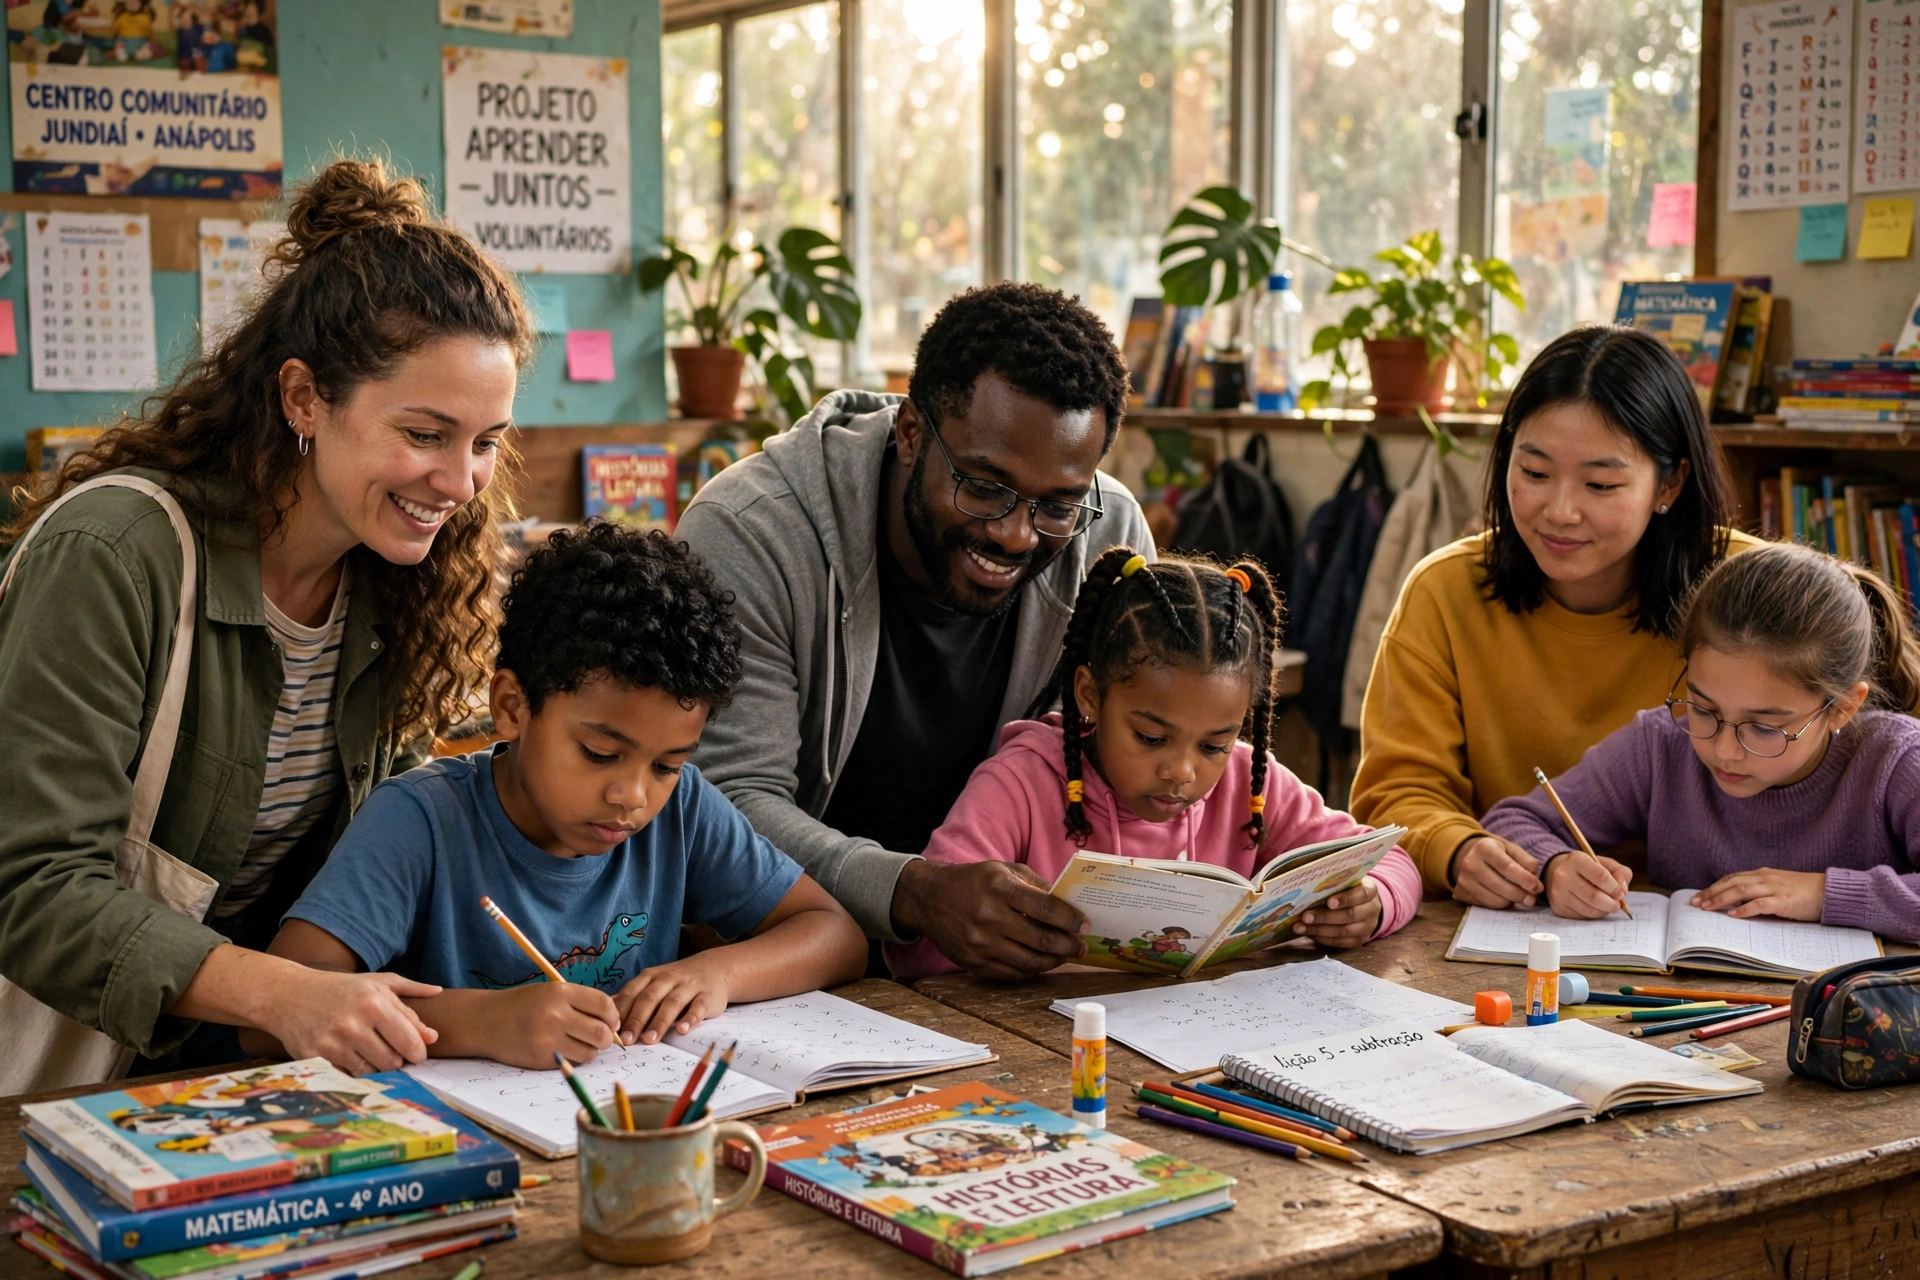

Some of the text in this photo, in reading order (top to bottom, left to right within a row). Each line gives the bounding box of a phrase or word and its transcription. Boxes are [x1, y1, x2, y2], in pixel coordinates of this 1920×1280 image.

[26, 83, 267, 120] CENTRO COMUNITÁRIO
[478, 82, 597, 123] PROJETO
[41, 117, 128, 146] JUNDIAÍ
[153, 125, 255, 152] ANÁPOLIS
[465, 126, 609, 167] APRENDER
[475, 219, 613, 253] VOLUNTÁRIOS
[1319, 1046, 1335, 1060] 5
[1350, 1031, 1424, 1054] subtração
[931, 1157, 1110, 1209] HISTÓRIAS
[968, 1174, 1145, 1224] E LEITURA
[185, 1197, 329, 1240] MATEMÁTICA
[349, 1189, 372, 1212] 4º
[377, 1181, 424, 1207] ANO
[784, 1174, 903, 1245] HISTÓRIAS E LEITURA
